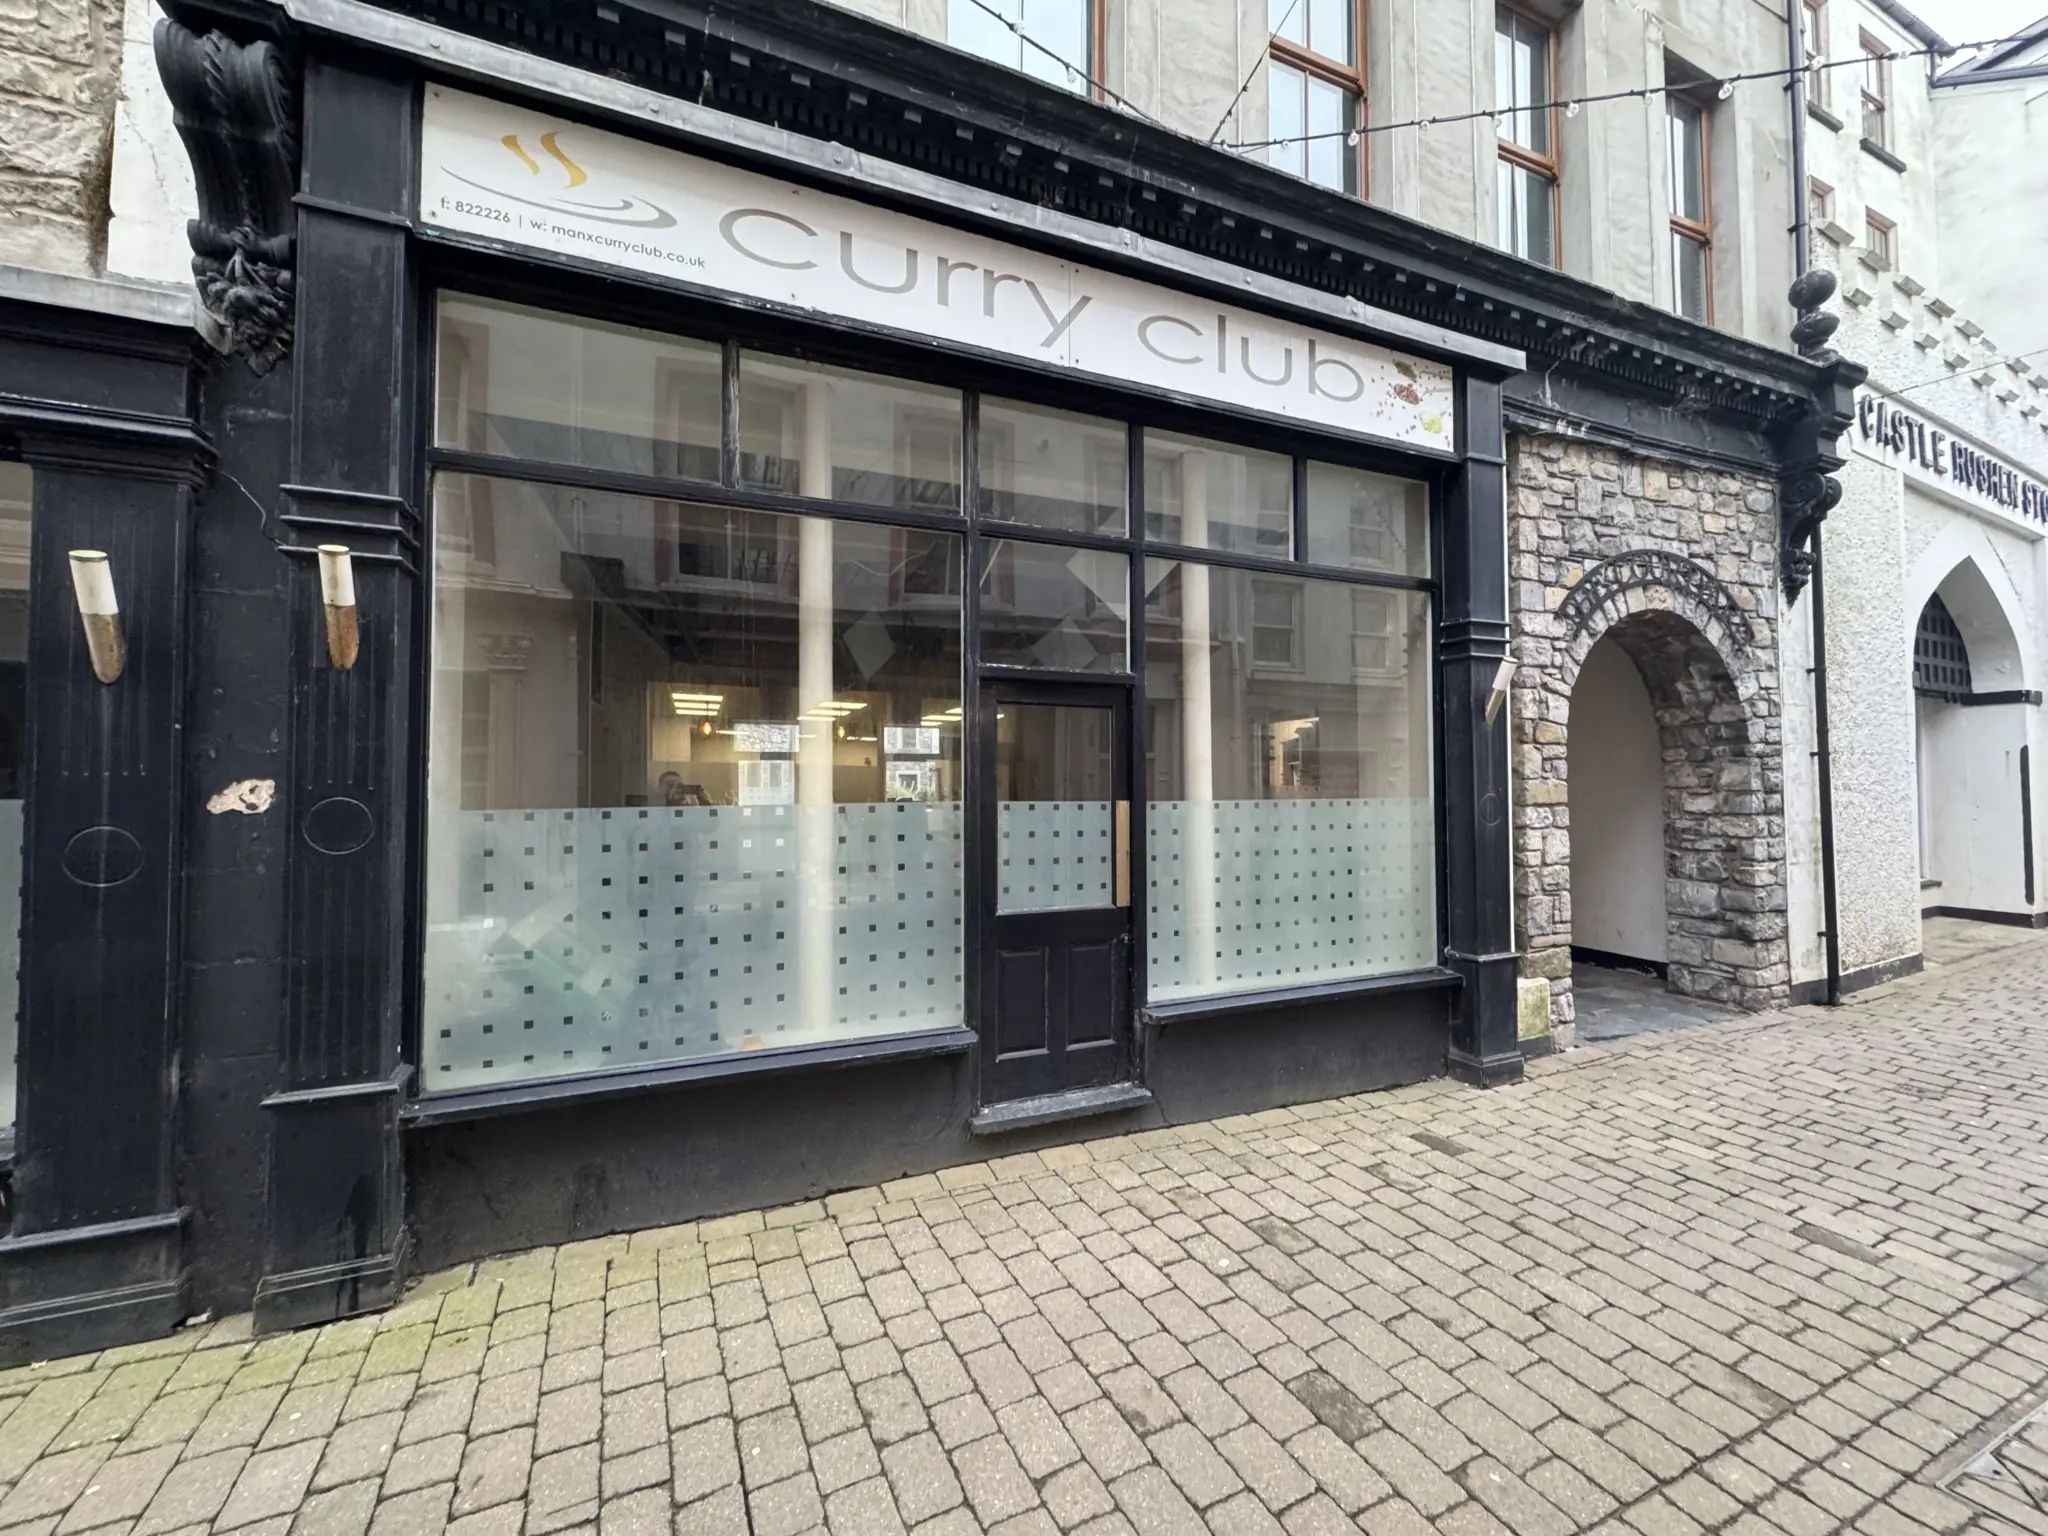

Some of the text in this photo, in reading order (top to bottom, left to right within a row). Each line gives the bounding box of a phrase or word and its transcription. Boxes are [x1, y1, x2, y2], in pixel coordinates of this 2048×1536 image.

[441, 196, 450, 210] t:
[455, 201, 511, 223] 822226
[530, 219, 547, 231] w:
[552, 224, 706, 269] manxcurryclub.co.uk
[1137, 314, 1365, 403] club
[1859, 394, 1948, 475] CASTLE
[1951, 440, 2019, 509] RUSHEN
